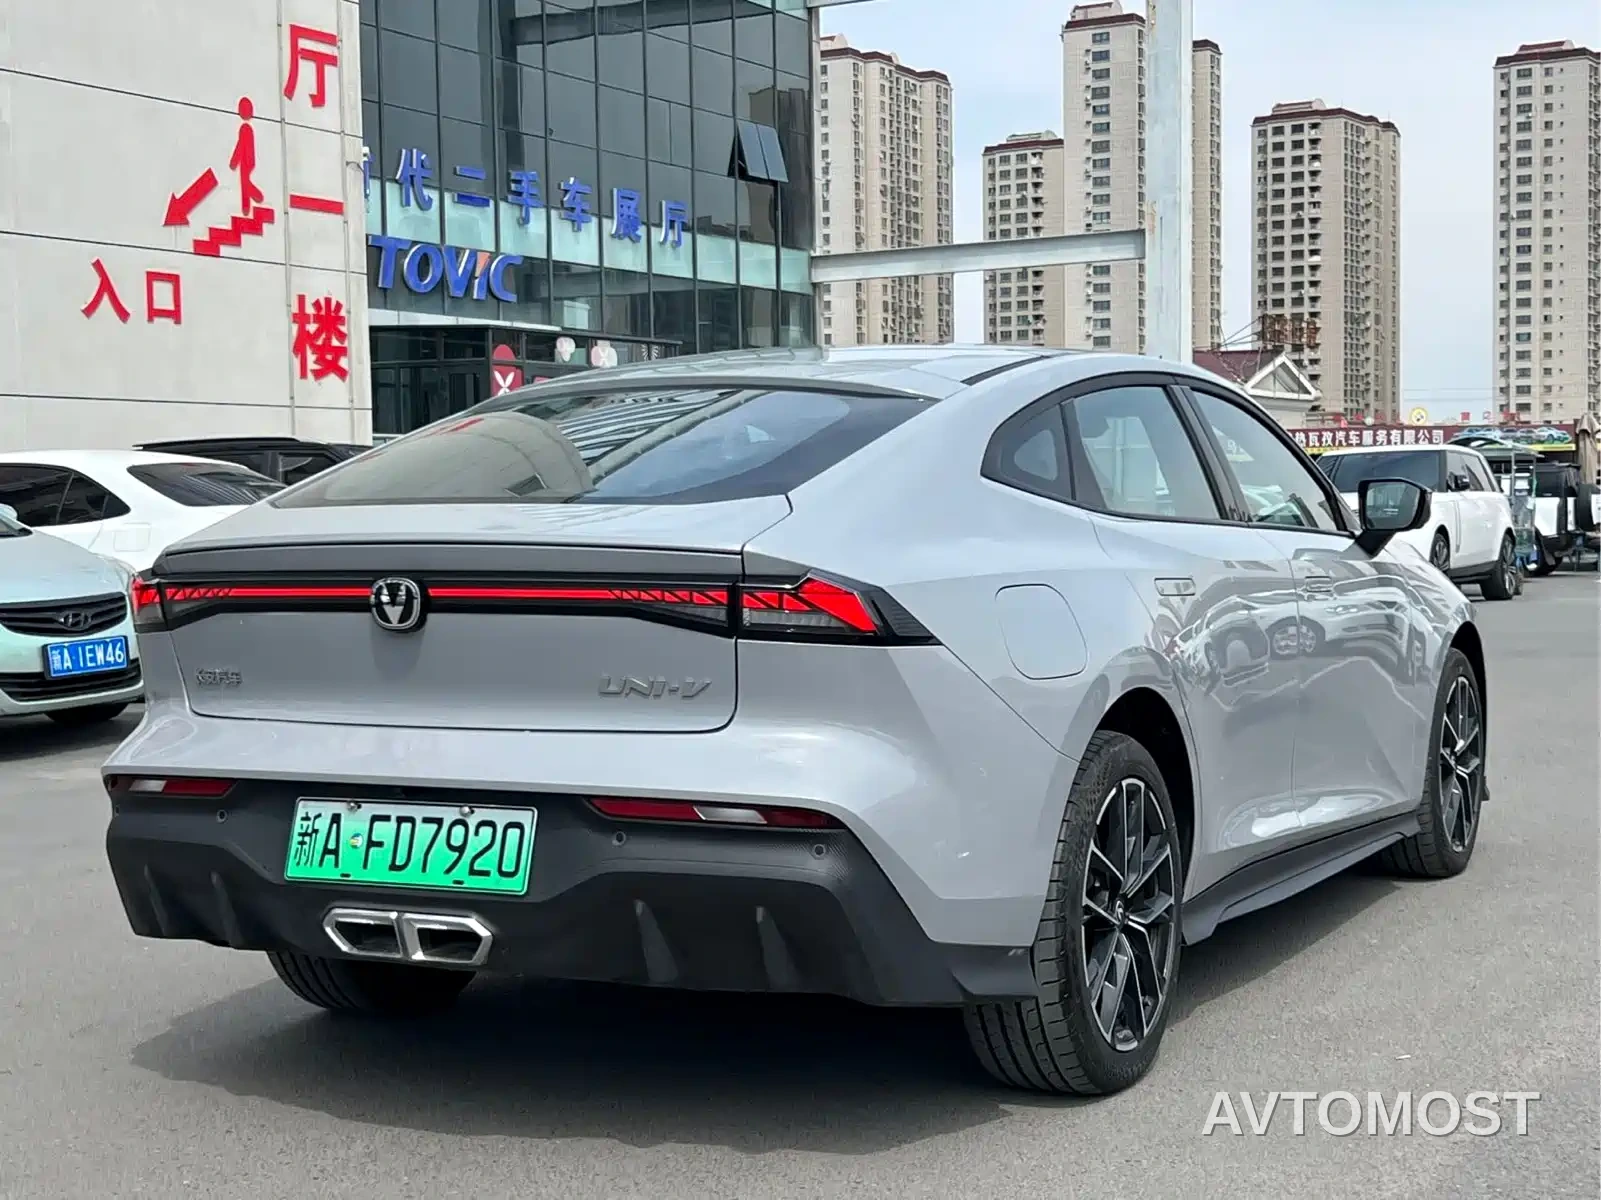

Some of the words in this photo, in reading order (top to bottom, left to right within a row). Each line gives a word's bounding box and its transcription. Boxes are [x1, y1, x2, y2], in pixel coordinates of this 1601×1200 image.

[81, 258, 182, 324] 入口
[368, 235, 523, 303] TOVIC
[599, 674, 710, 698] UNI-V
